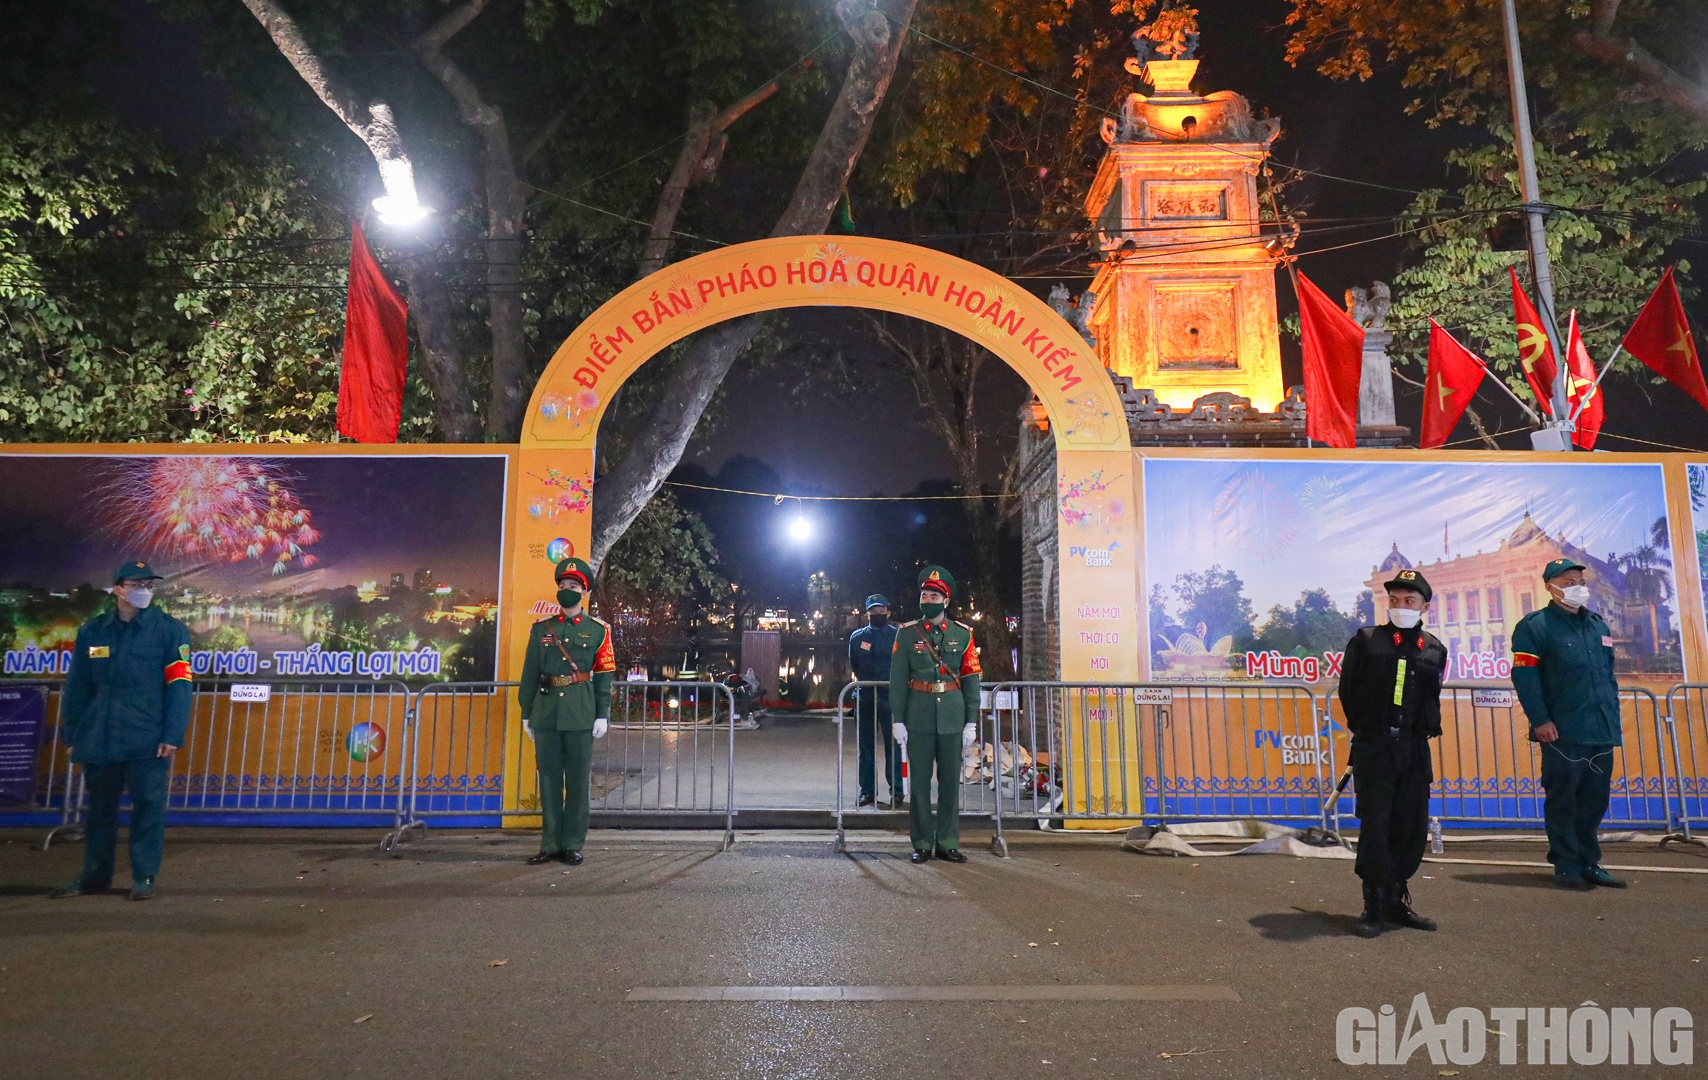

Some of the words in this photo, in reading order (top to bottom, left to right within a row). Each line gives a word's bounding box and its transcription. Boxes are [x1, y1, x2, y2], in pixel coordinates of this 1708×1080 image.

[573, 325, 635, 390] ĐIỂM
[631, 290, 693, 335] BẮN
[697, 263, 777, 304] PHÁO
[786, 260, 848, 286] HOA
[856, 262, 940, 296] QUẬN
[943, 280, 1025, 336] HOÀN
[1021, 327, 1082, 392] KIẾM
[1085, 557, 1113, 567] Bank
[1077, 605, 1100, 619] NĂM
[1102, 605, 1121, 619] MỚI
[1080, 629, 1104, 644] THỜI
[1106, 631, 1120, 644] CƠ
[5, 645, 58, 673] NĂM
[190, 652, 211, 673] Ơ
[213, 647, 256, 673] MỚI
[275, 644, 352, 674] THẮNG
[356, 651, 393, 678] LỢI
[398, 647, 440, 674] MỚI
[1090, 655, 1109, 670] MỚI
[1247, 651, 1318, 683] Mừng
[1459, 651, 1512, 679] Mão
[1136, 693, 1157, 701] DỪNG
